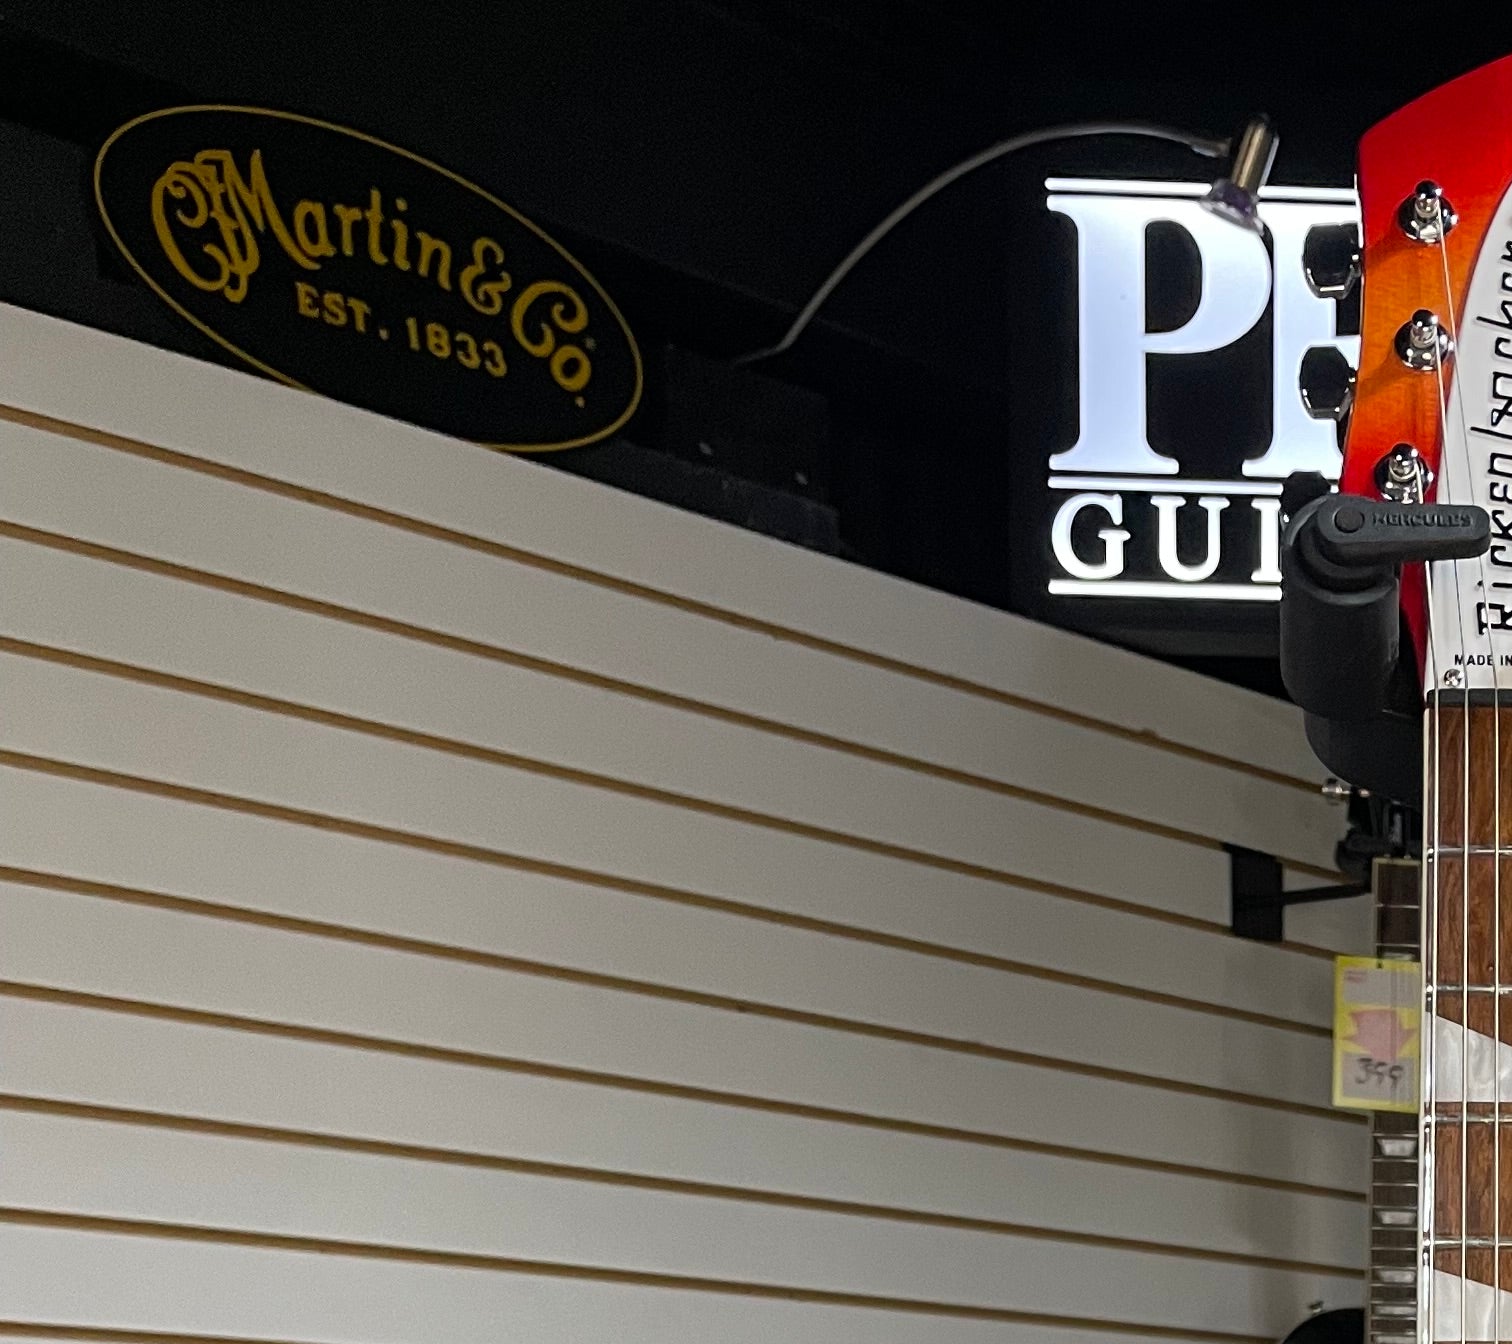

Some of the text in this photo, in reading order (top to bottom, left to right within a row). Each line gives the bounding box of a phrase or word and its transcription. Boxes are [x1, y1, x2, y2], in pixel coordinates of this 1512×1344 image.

[294, 280, 508, 378] EST. 1833
[1454, 653, 1494, 668] MADE
